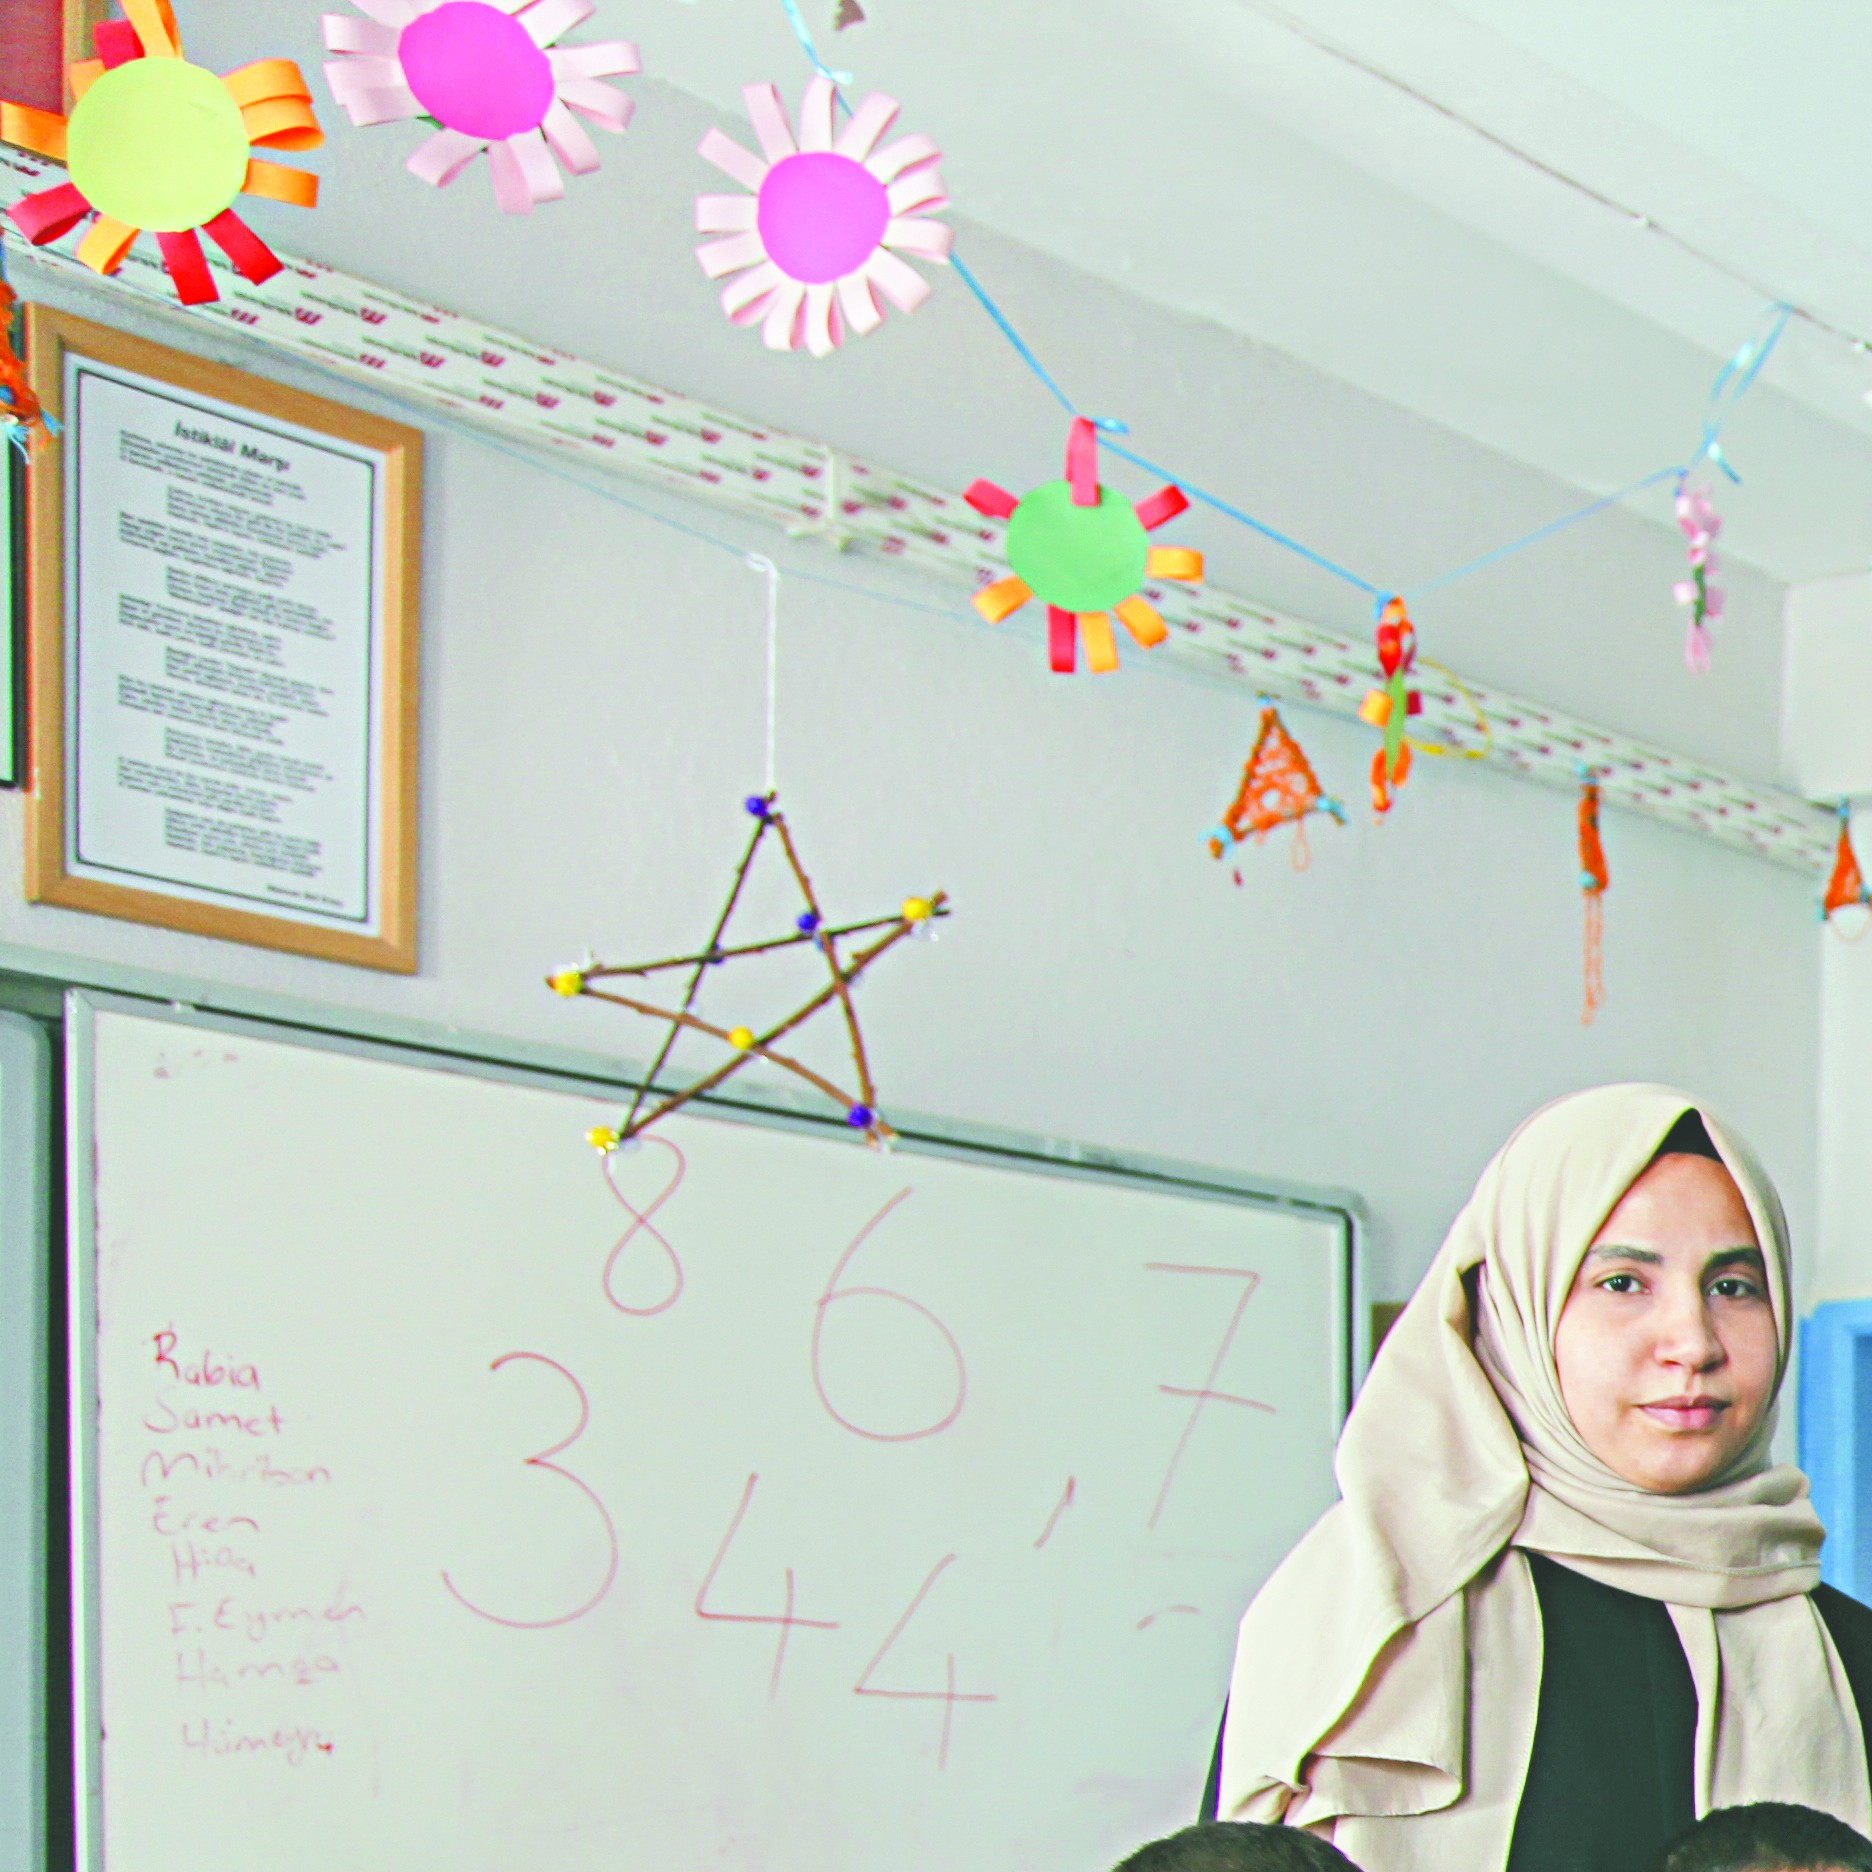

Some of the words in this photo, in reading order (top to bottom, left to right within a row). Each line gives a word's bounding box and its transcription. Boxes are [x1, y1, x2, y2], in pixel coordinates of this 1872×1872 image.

[601, 1133, 686, 1317] 8
[811, 1186, 967, 1443] 6
[143, 1385, 282, 1438] Samet
[152, 1325, 261, 1392] Rabia
[1144, 1260, 1276, 1528] 7
[441, 1350, 619, 1630] 3
[695, 1471, 841, 1700] 4
[853, 1552, 997, 1771] 4
